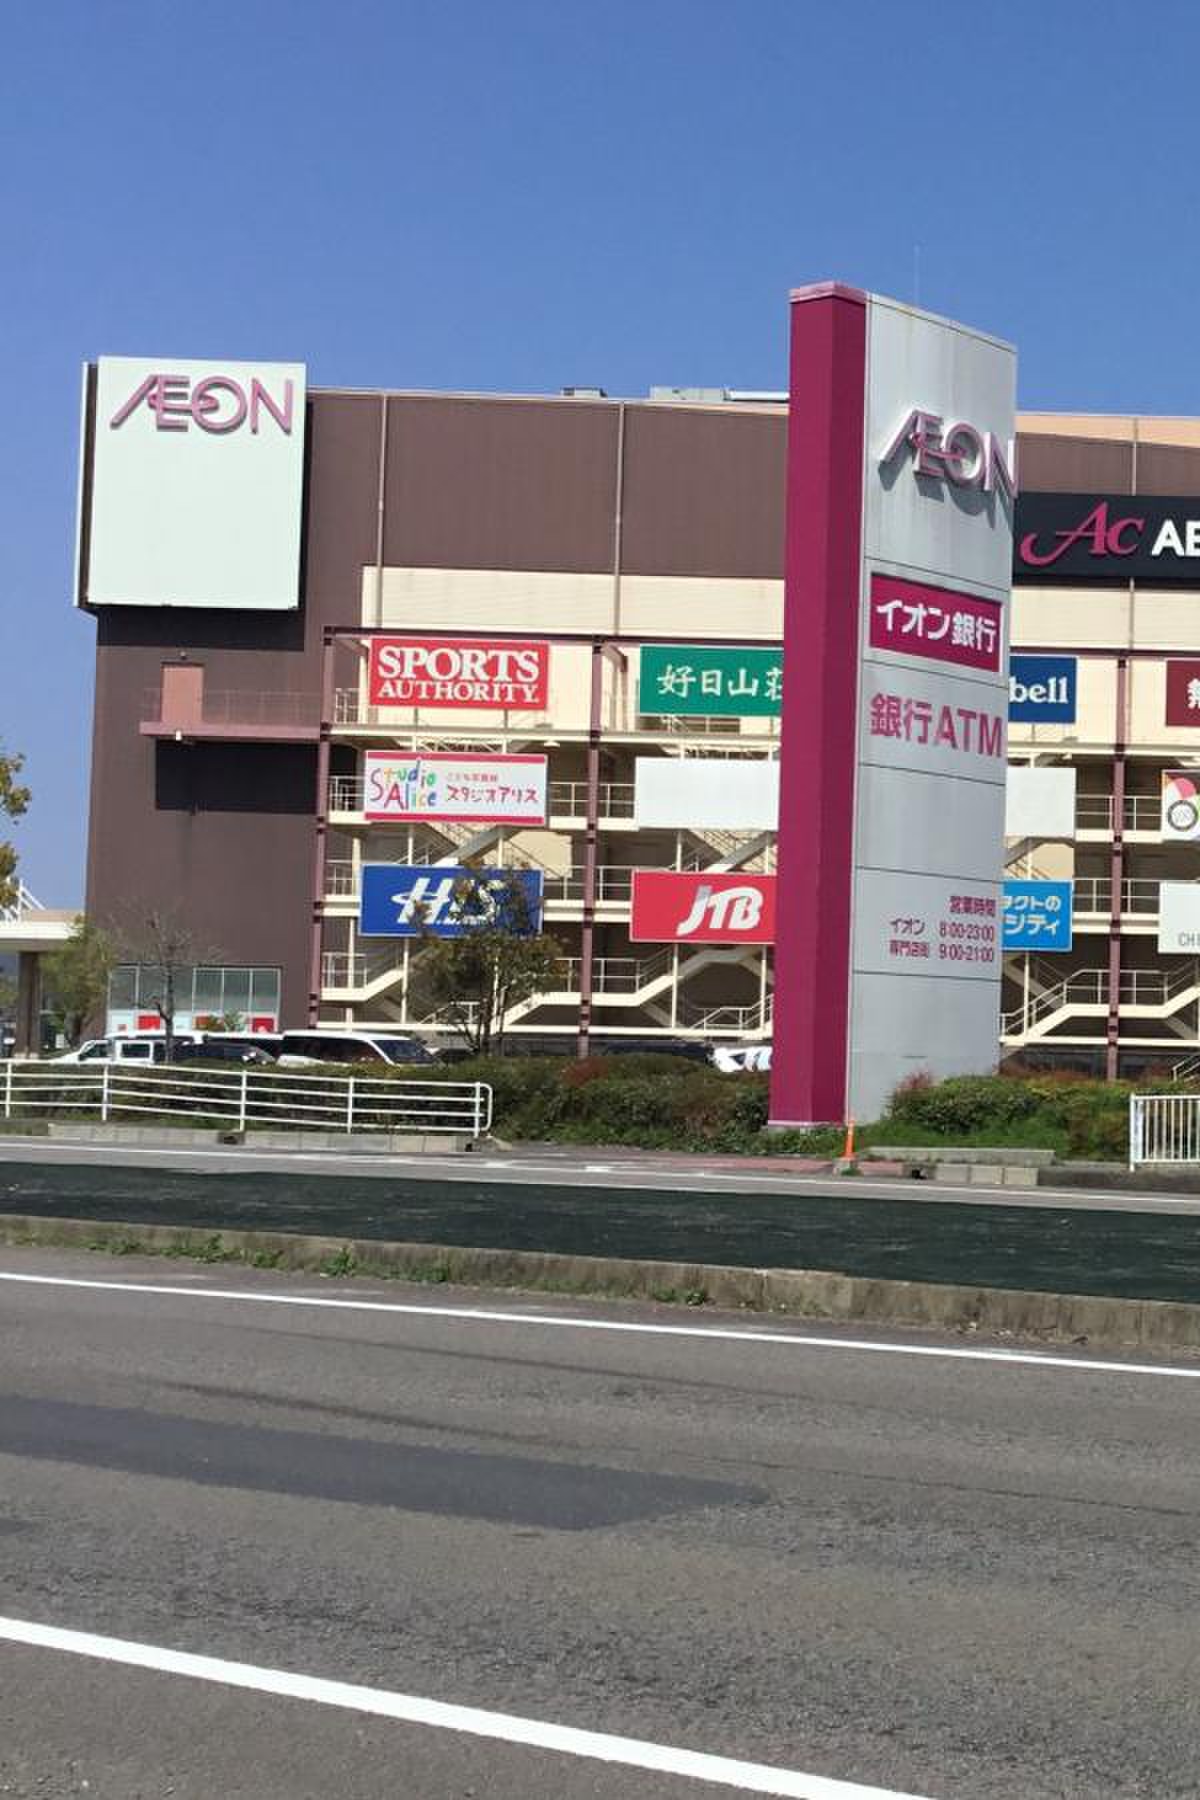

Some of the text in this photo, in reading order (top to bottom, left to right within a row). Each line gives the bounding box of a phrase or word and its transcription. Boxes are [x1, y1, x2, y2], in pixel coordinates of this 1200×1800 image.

[876, 600, 997, 653] イオン銀行
[378, 646, 540, 683] SPORTS
[378, 680, 540, 704] AUTHORITY
[869, 692, 1002, 758] 銀行ATM
[447, 784, 539, 805] スタジオアリス
[676, 885, 764, 936] JTB
[890, 918, 926, 936] イオン
